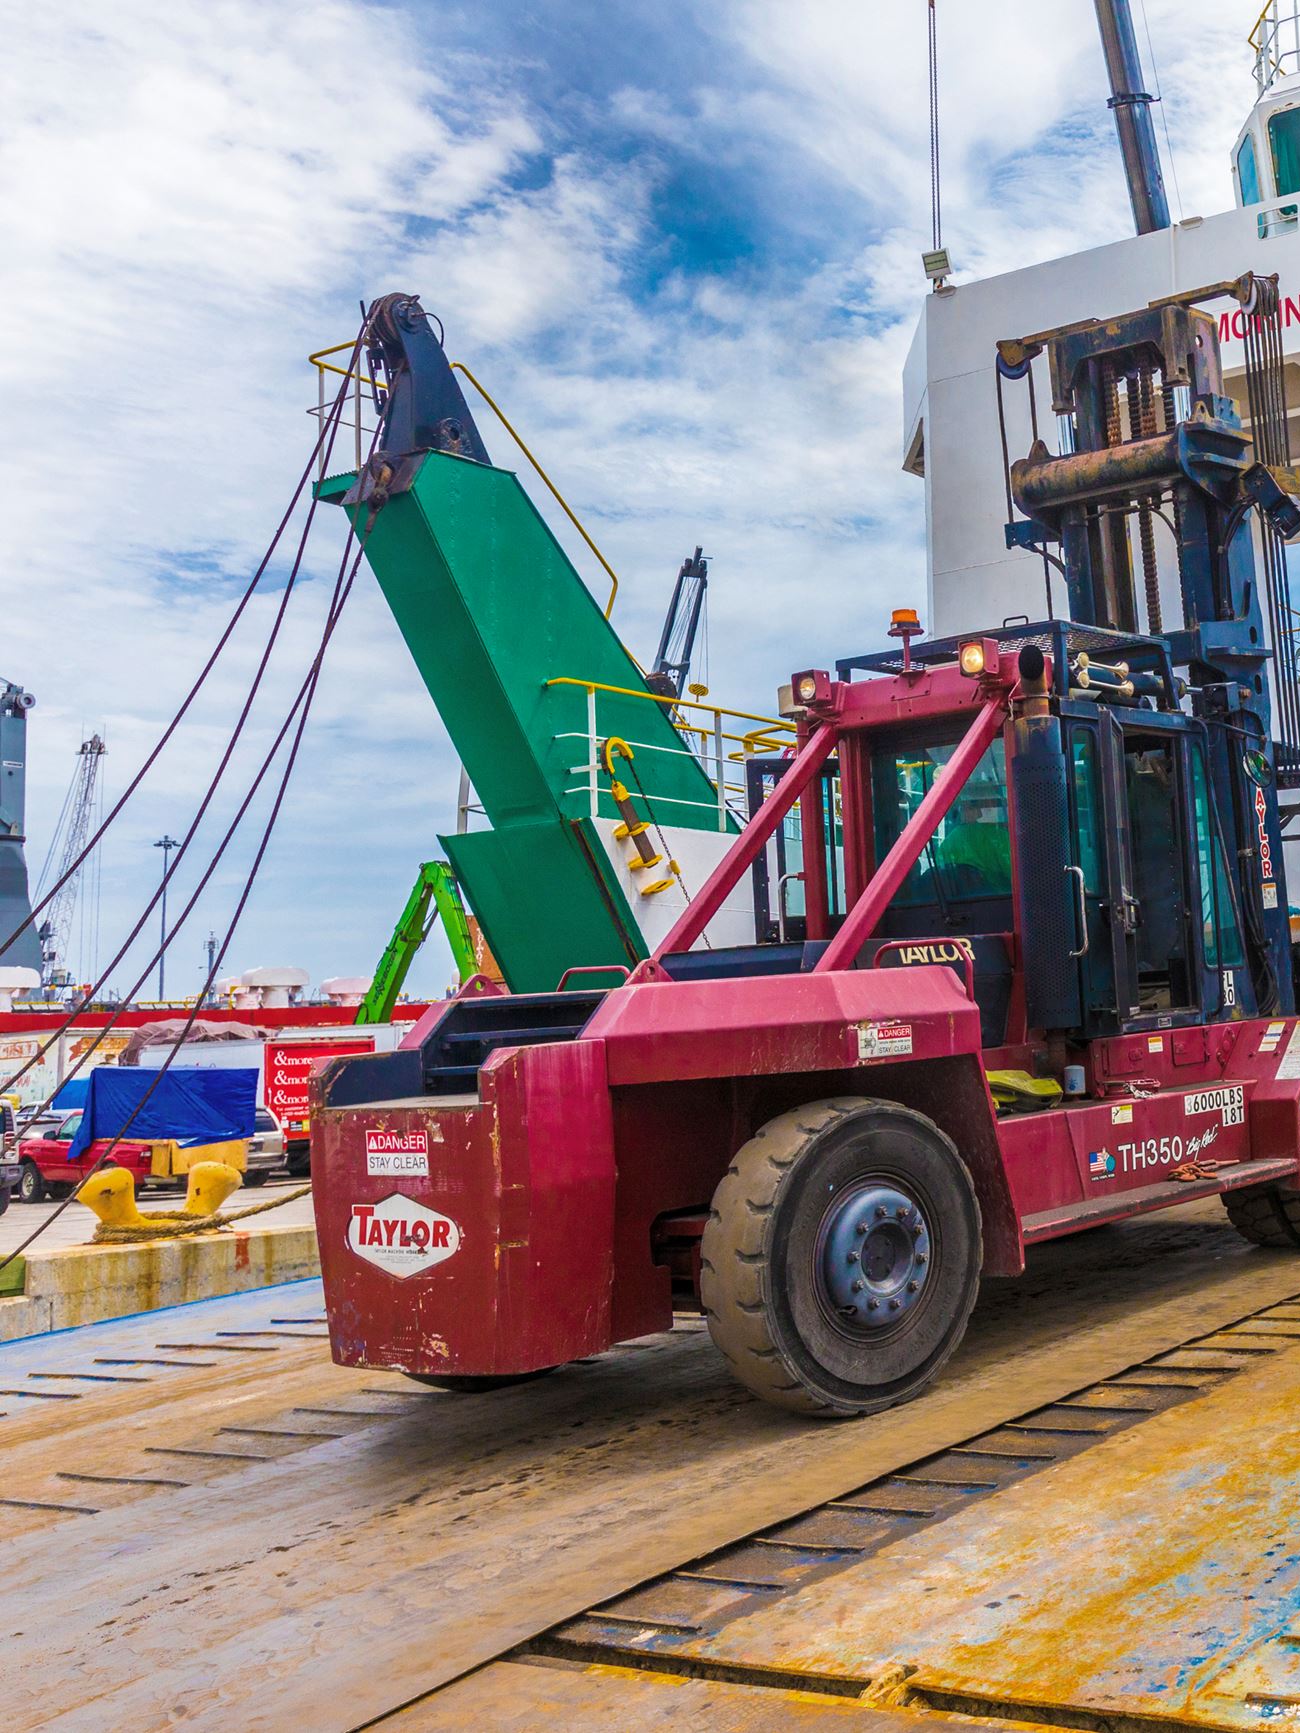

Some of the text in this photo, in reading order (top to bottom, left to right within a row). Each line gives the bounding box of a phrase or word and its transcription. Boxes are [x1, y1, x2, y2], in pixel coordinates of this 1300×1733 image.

[884, 1028, 910, 1037] DANGER
[879, 1046, 891, 1054] STAY
[274, 1051, 313, 1066] &more
[274, 1070, 308, 1085] &mor
[1186, 1087, 1243, 1114] 36000LBS
[1224, 1105, 1243, 1125] 18T
[378, 1135, 425, 1150] DANGER
[1118, 1136, 1183, 1172] TH350
[369, 1156, 426, 1169] STAY CLEAR
[353, 1206, 450, 1248] TAYLOR
